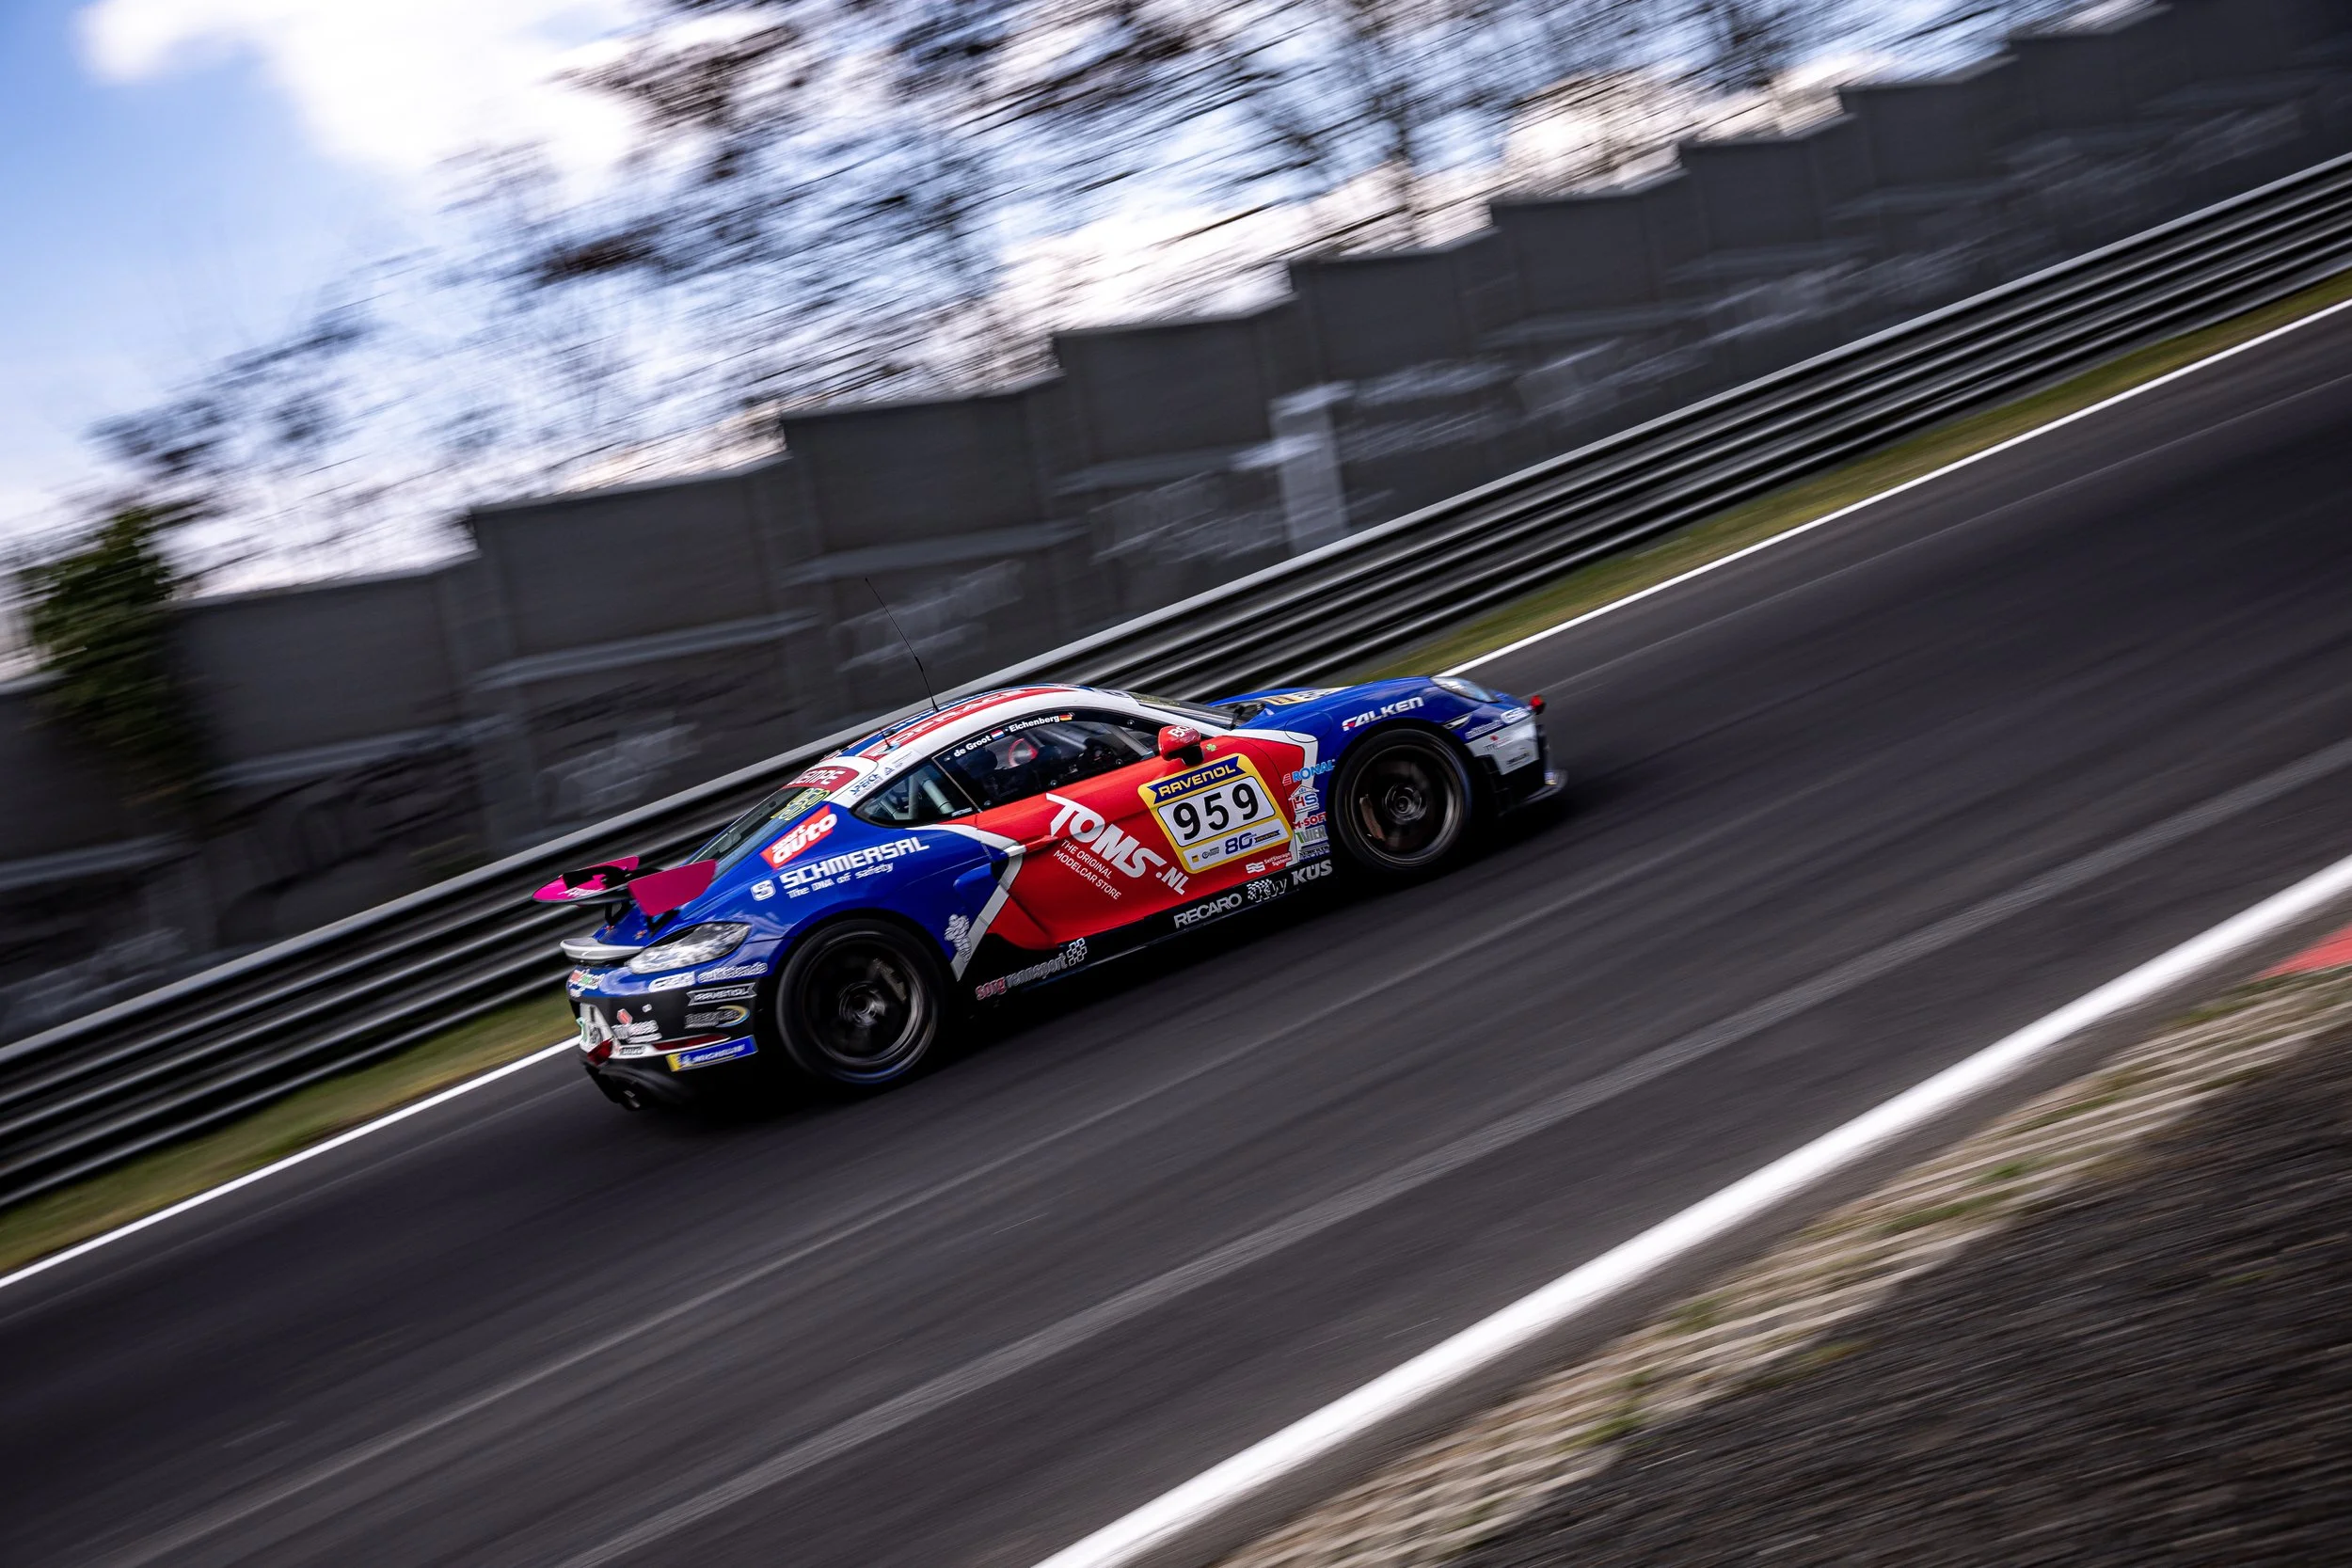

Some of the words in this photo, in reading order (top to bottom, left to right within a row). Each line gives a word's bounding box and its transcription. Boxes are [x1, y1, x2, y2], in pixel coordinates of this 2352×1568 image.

[1009, 716, 1060, 733] Eichenberg
[1342, 697, 1425, 731] FALKEN
[953, 746, 966, 757] de
[965, 735, 992, 751] Groot
[1158, 763, 1236, 797] RAVENOL
[1292, 759, 1335, 783] RONAL
[1173, 783, 1259, 841] 959
[1293, 794, 1318, 809] HS
[772, 813, 837, 864] auto
[1225, 832, 1252, 855] 80
[779, 836, 930, 889] SCHMERSAL
[1054, 849, 1098, 887] MODELCAR
[1095, 879, 1122, 900] STORE
[1061, 839, 1078, 855] THE
[1076, 850, 1113, 879] ORIGINAL
[1291, 860, 1333, 886] KÜS
[787, 885, 810, 898] The
[811, 878, 834, 892] DNA
[836, 873, 851, 884] of
[855, 863, 894, 879] safety
[1173, 893, 1243, 928] RECARO
